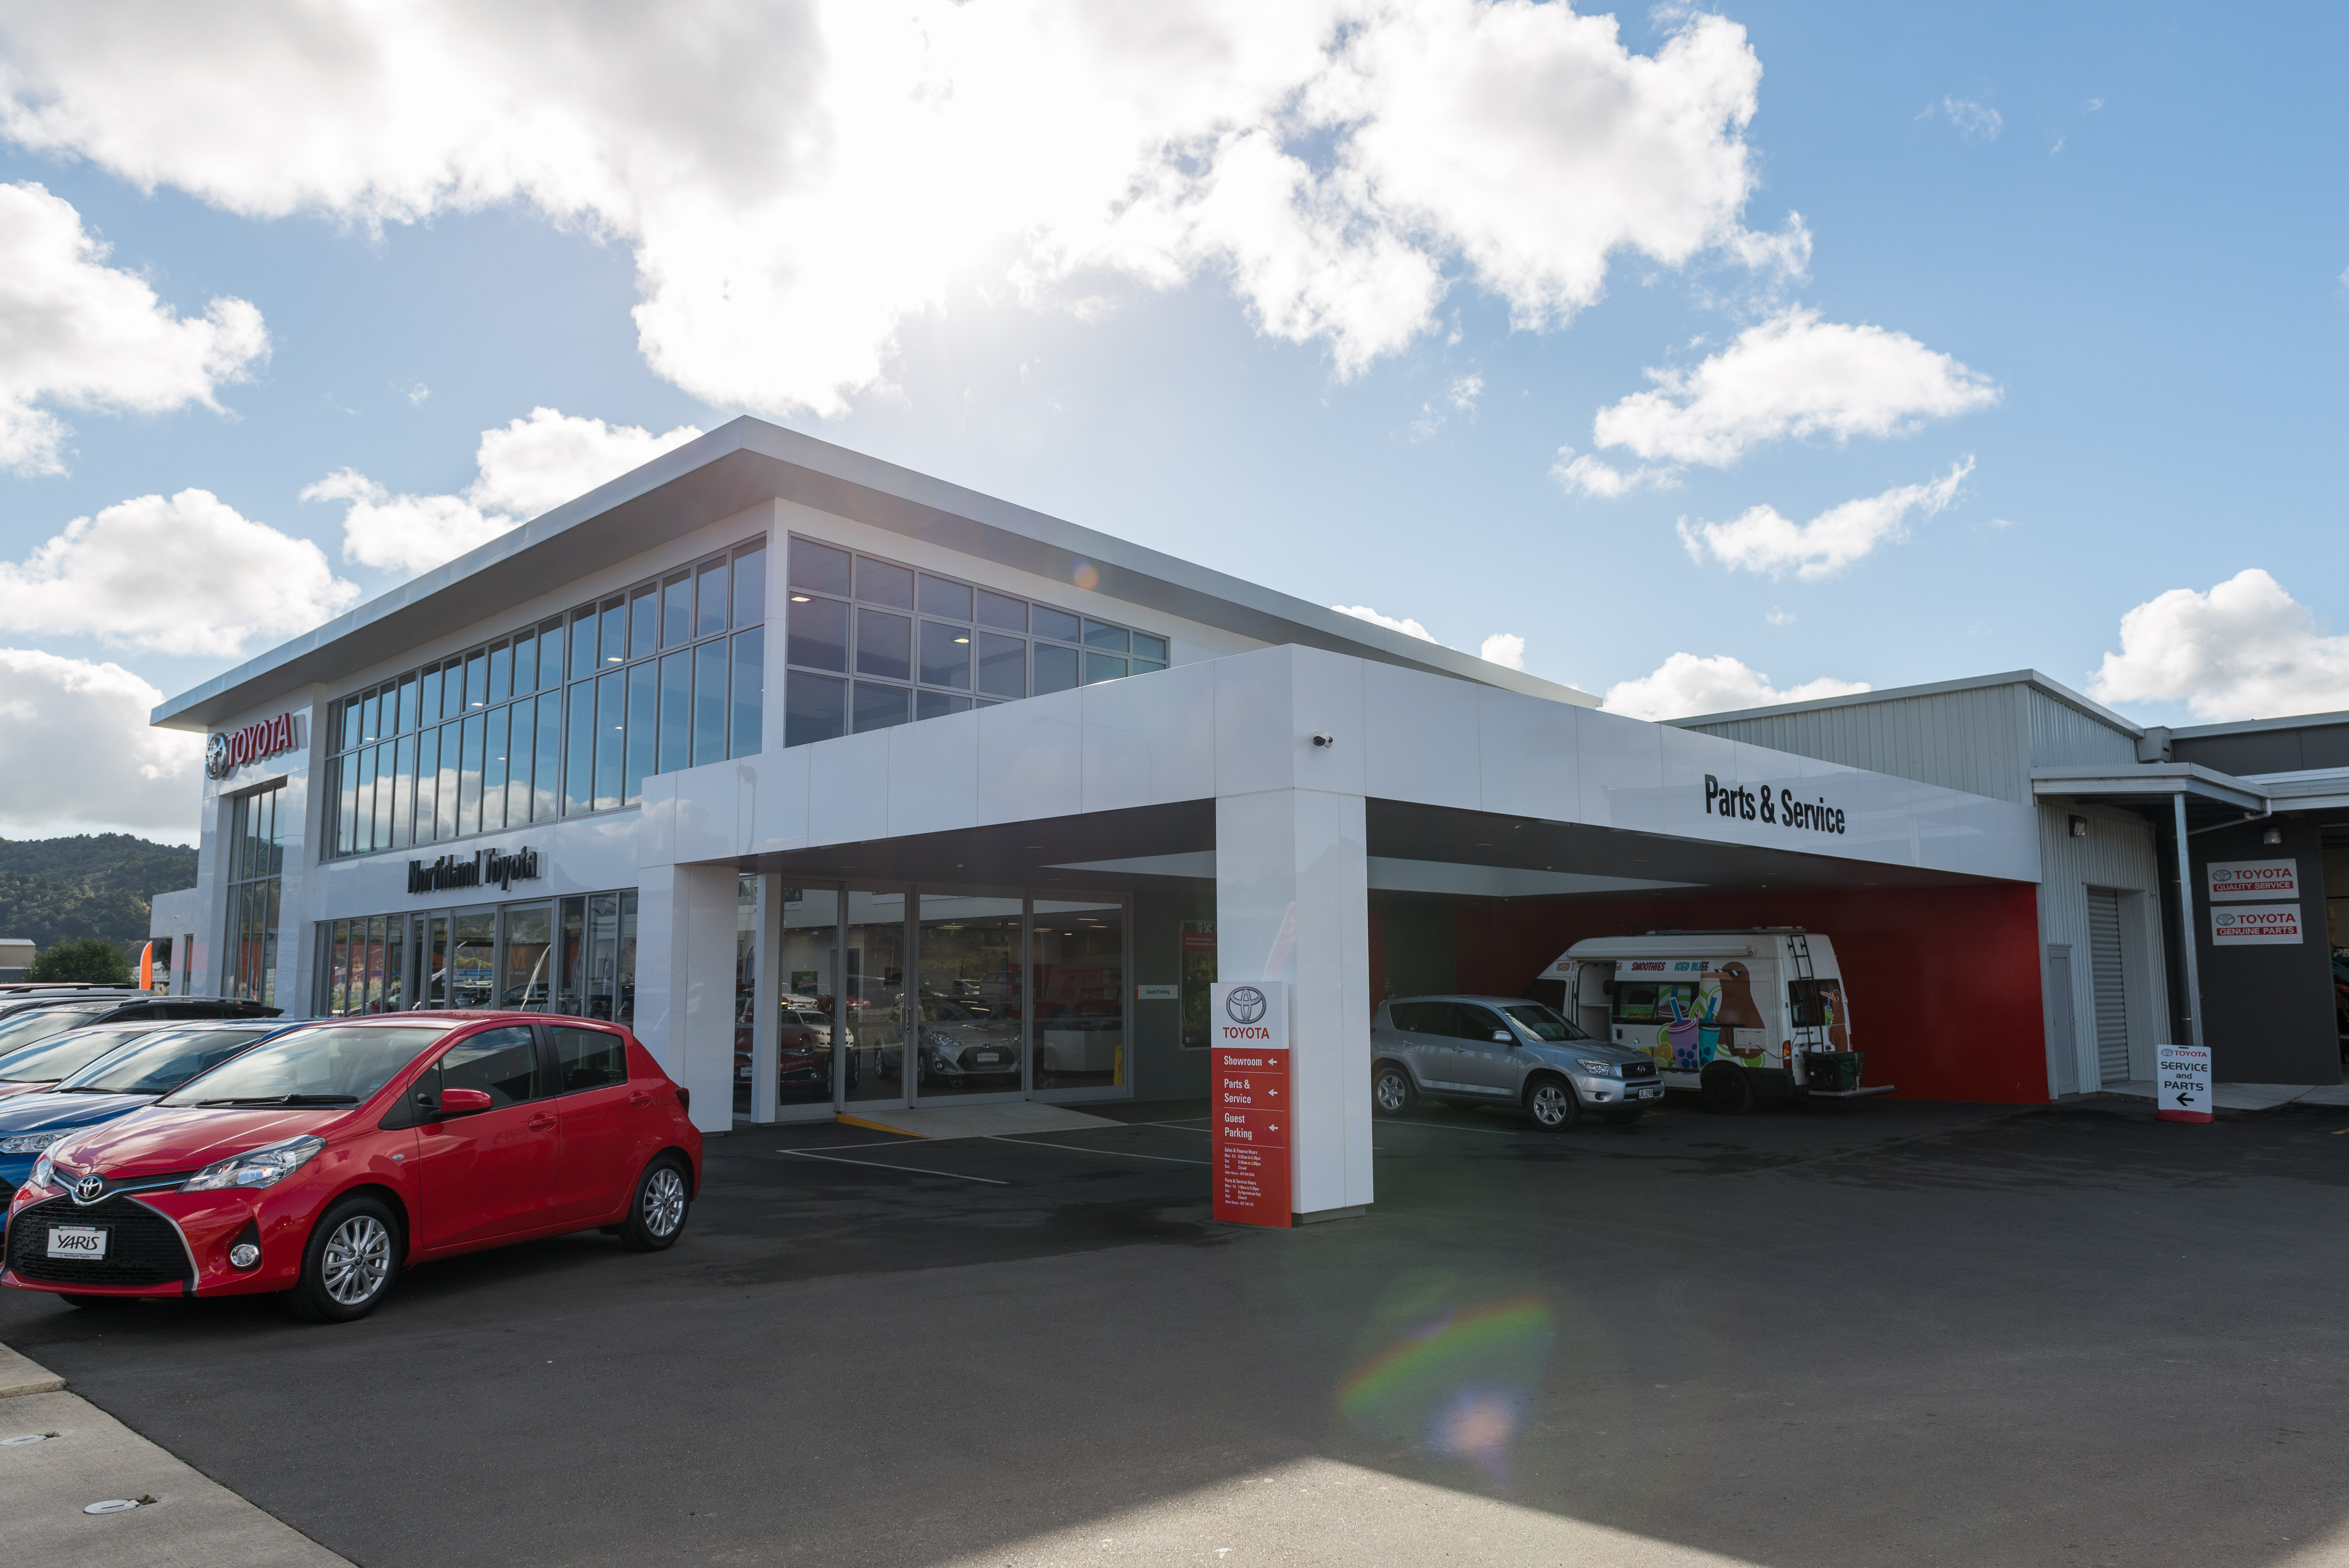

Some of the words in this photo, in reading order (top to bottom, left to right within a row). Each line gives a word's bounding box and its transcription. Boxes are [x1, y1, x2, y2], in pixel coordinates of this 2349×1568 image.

[228, 713, 292, 767] TOYOTA
[1705, 774, 1756, 820] Parts
[1760, 784, 1777, 824] &
[1781, 789, 1845, 834] Service
[407, 850, 481, 893] Northland
[483, 846, 540, 891] Toyota
[2234, 868, 2293, 880] TOYOTA
[2216, 883, 2252, 891] QUALITY
[2255, 882, 2290, 890] SERVICE
[2237, 913, 2296, 924] TOYOTA
[1631, 962, 1666, 971] SMOOTHIES
[1674, 962, 1690, 971] ICED
[1223, 1027, 1270, 1039] TOYOTA
[1224, 1055, 1262, 1066] Showroom
[2160, 1061, 2208, 1072] SERVICE
[1224, 1079, 1242, 1089] Parts
[1244, 1079, 1250, 1089] &
[2164, 1081, 2204, 1091] PARTS
[1224, 1093, 1252, 1103] Service
[1225, 1113, 1245, 1123] Guest
[1225, 1127, 1252, 1140] Parking
